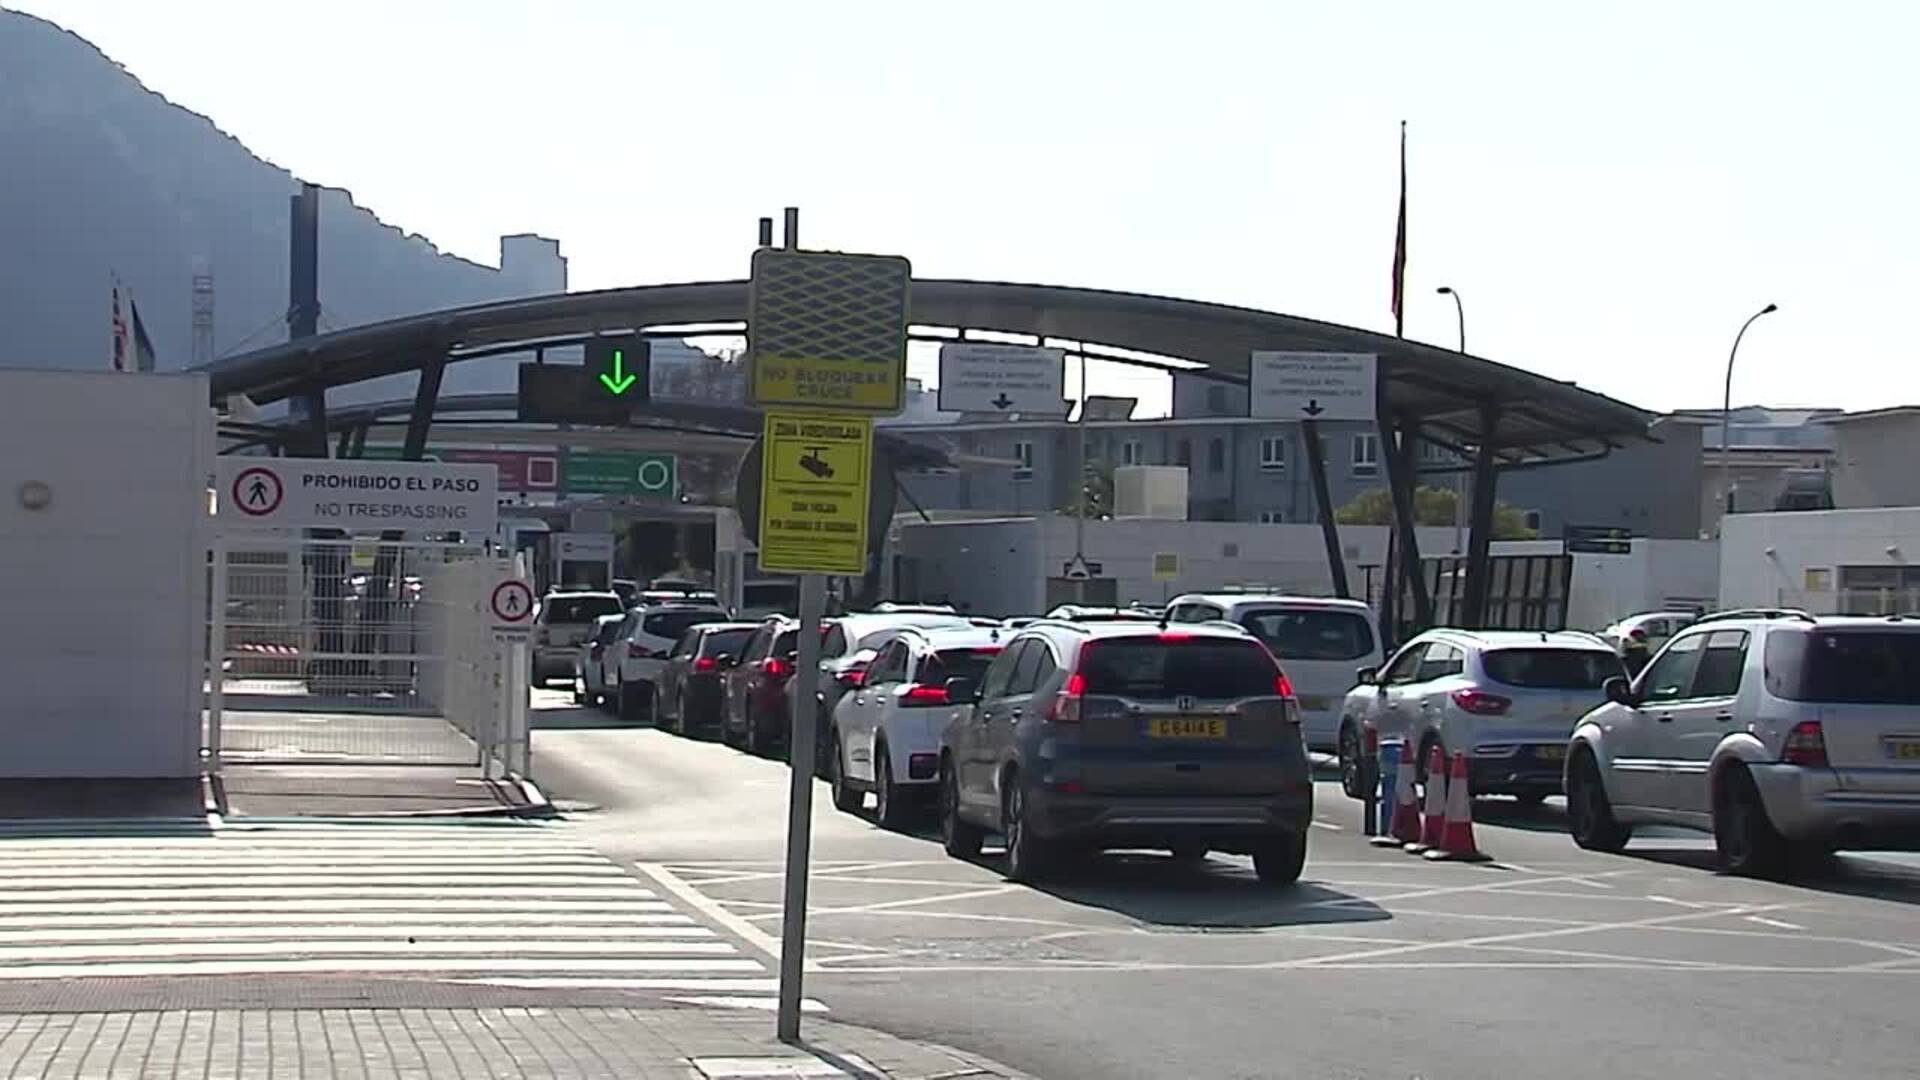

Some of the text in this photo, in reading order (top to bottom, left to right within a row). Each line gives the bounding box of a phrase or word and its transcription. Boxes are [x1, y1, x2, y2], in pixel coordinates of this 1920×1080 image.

[302, 474, 480, 492] PROHIBIDO EL PASO
[315, 502, 468, 519] NO TRESPASSING
